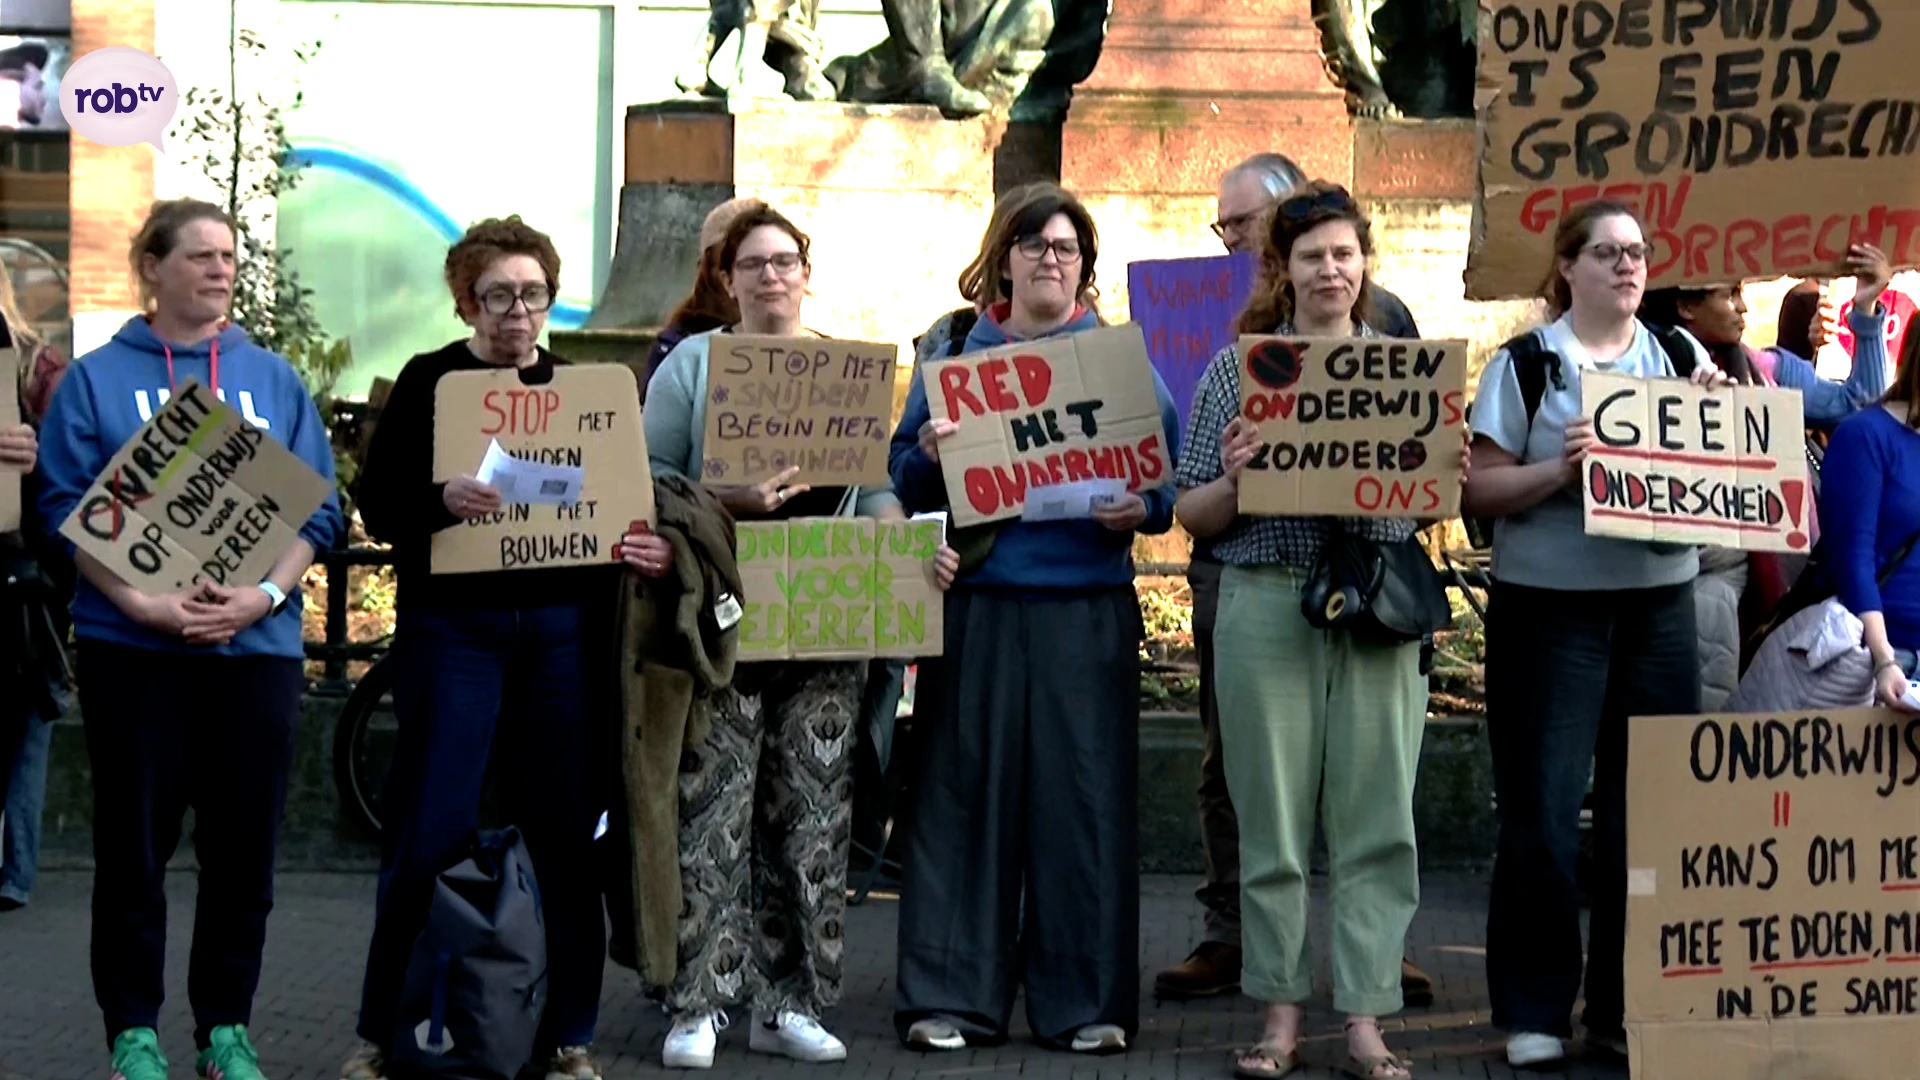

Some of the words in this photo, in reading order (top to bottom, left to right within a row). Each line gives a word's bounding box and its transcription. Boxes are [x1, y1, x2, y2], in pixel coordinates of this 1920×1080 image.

[1508, 49, 1606, 109] IS
[1656, 48, 1841, 112] EEN
[724, 346, 829, 378] STOP
[842, 354, 892, 381] MET
[1325, 344, 1446, 381] GEEN
[481, 389, 560, 436] STOP
[578, 411, 617, 433] MET
[939, 355, 1052, 422] RED
[1244, 388, 1463, 437] ONDERWIJS
[826, 416, 880, 439] MET
[1010, 399, 1104, 452] HET
[1593, 389, 1770, 454] GEEN
[743, 446, 868, 476] BOUWEN
[964, 434, 1163, 516] ONDERWIJS
[1246, 440, 1397, 471] ZONDER
[128, 523, 172, 574] OP
[166, 423, 263, 528] ONDERWIJS
[557, 500, 598, 520] MET
[1355, 475, 1440, 511] ONS
[190, 494, 281, 597] DEREEN
[501, 533, 598, 567] BOUWEN
[775, 560, 894, 606] VOOR
[740, 601, 926, 649] EDEREEN
[1690, 716, 1920, 798] ONDERWIJS
[1681, 837, 1779, 891] KANS
[1808, 835, 1855, 885] OM
[1660, 918, 1724, 968] MEE
[1739, 914, 1780, 962] TE
[1717, 984, 1752, 1019] IN
[1771, 981, 1818, 1016] DE
[1844, 977, 1918, 1015] SAME
